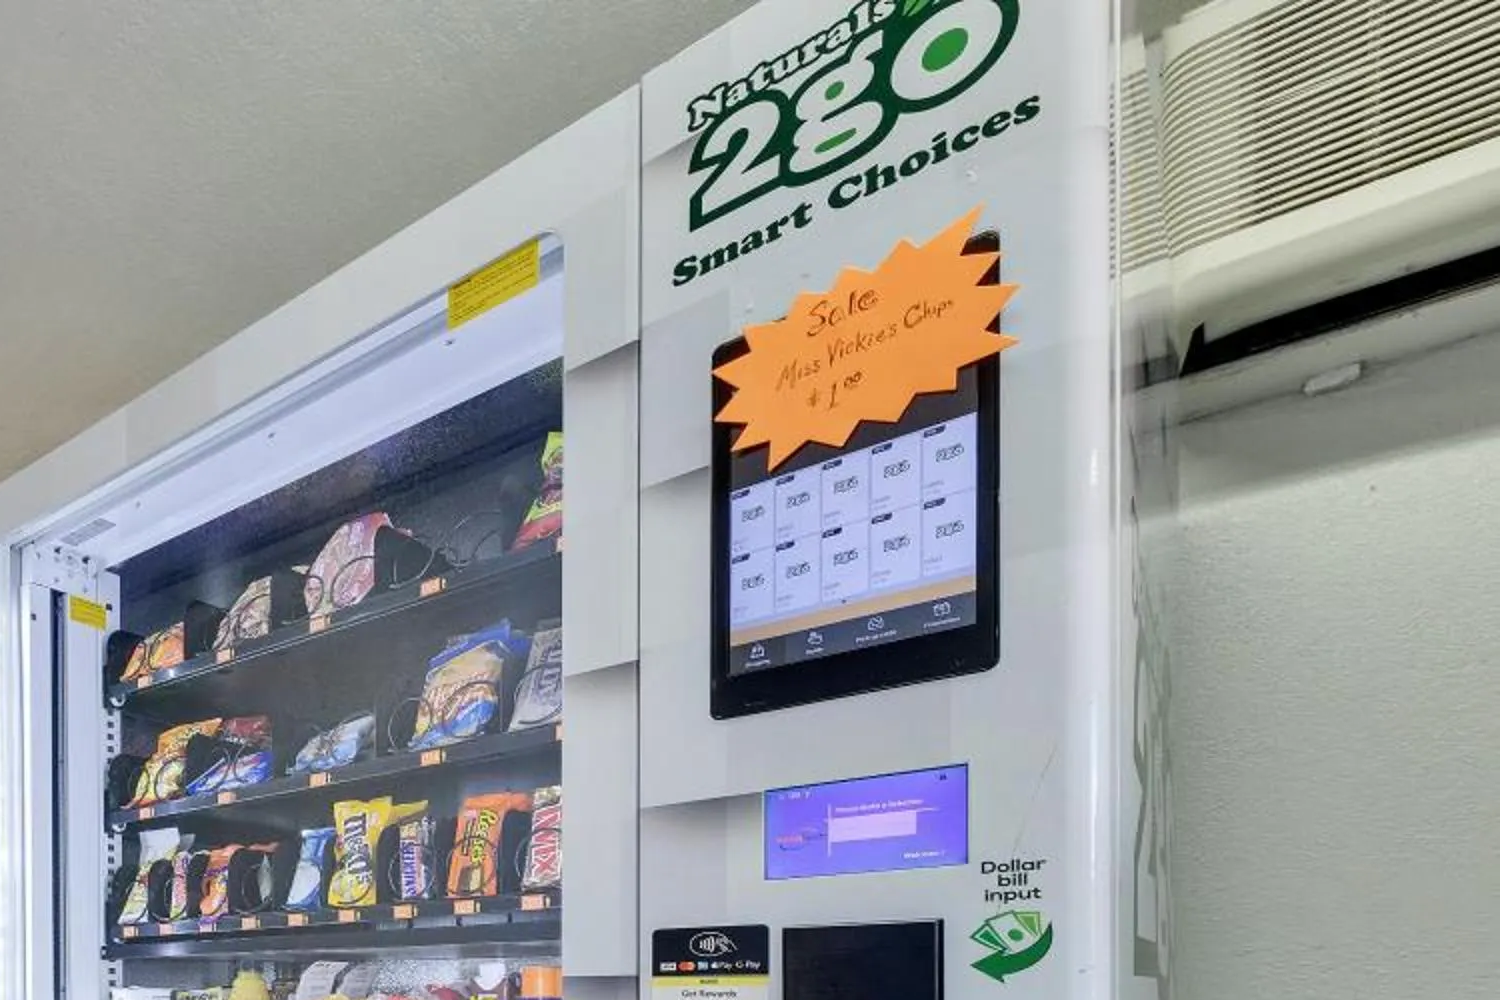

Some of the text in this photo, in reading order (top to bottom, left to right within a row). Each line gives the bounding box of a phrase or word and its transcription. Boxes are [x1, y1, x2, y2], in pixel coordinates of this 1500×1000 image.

[687, 0, 897, 132] Naturals
[672, 95, 1041, 287] Smart Choices
[806, 289, 879, 337] Sale
[776, 360, 821, 391] Miss
[981, 857, 1047, 874] Dollar
[997, 871, 1028, 887] bill
[985, 887, 1042, 904] input
